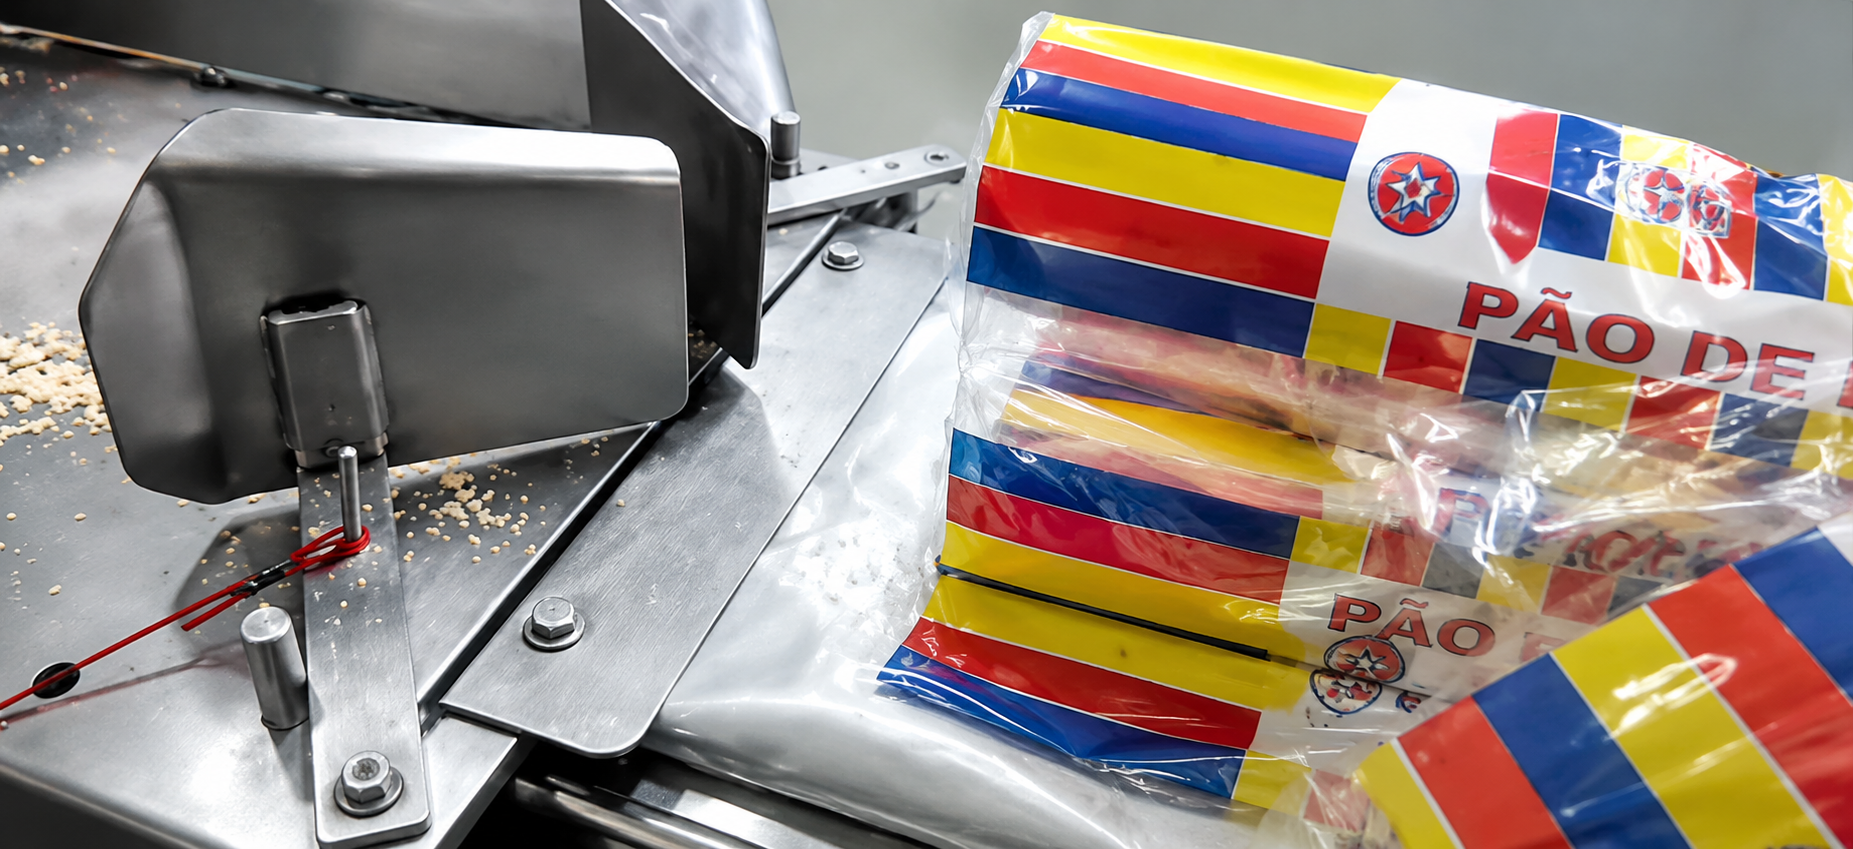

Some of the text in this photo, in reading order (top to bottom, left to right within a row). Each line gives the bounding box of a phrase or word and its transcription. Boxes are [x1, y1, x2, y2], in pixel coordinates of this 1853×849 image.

[1457, 281, 1655, 364] PÃO
[1680, 330, 1815, 401] DE
[1327, 593, 1496, 657] PÃO
